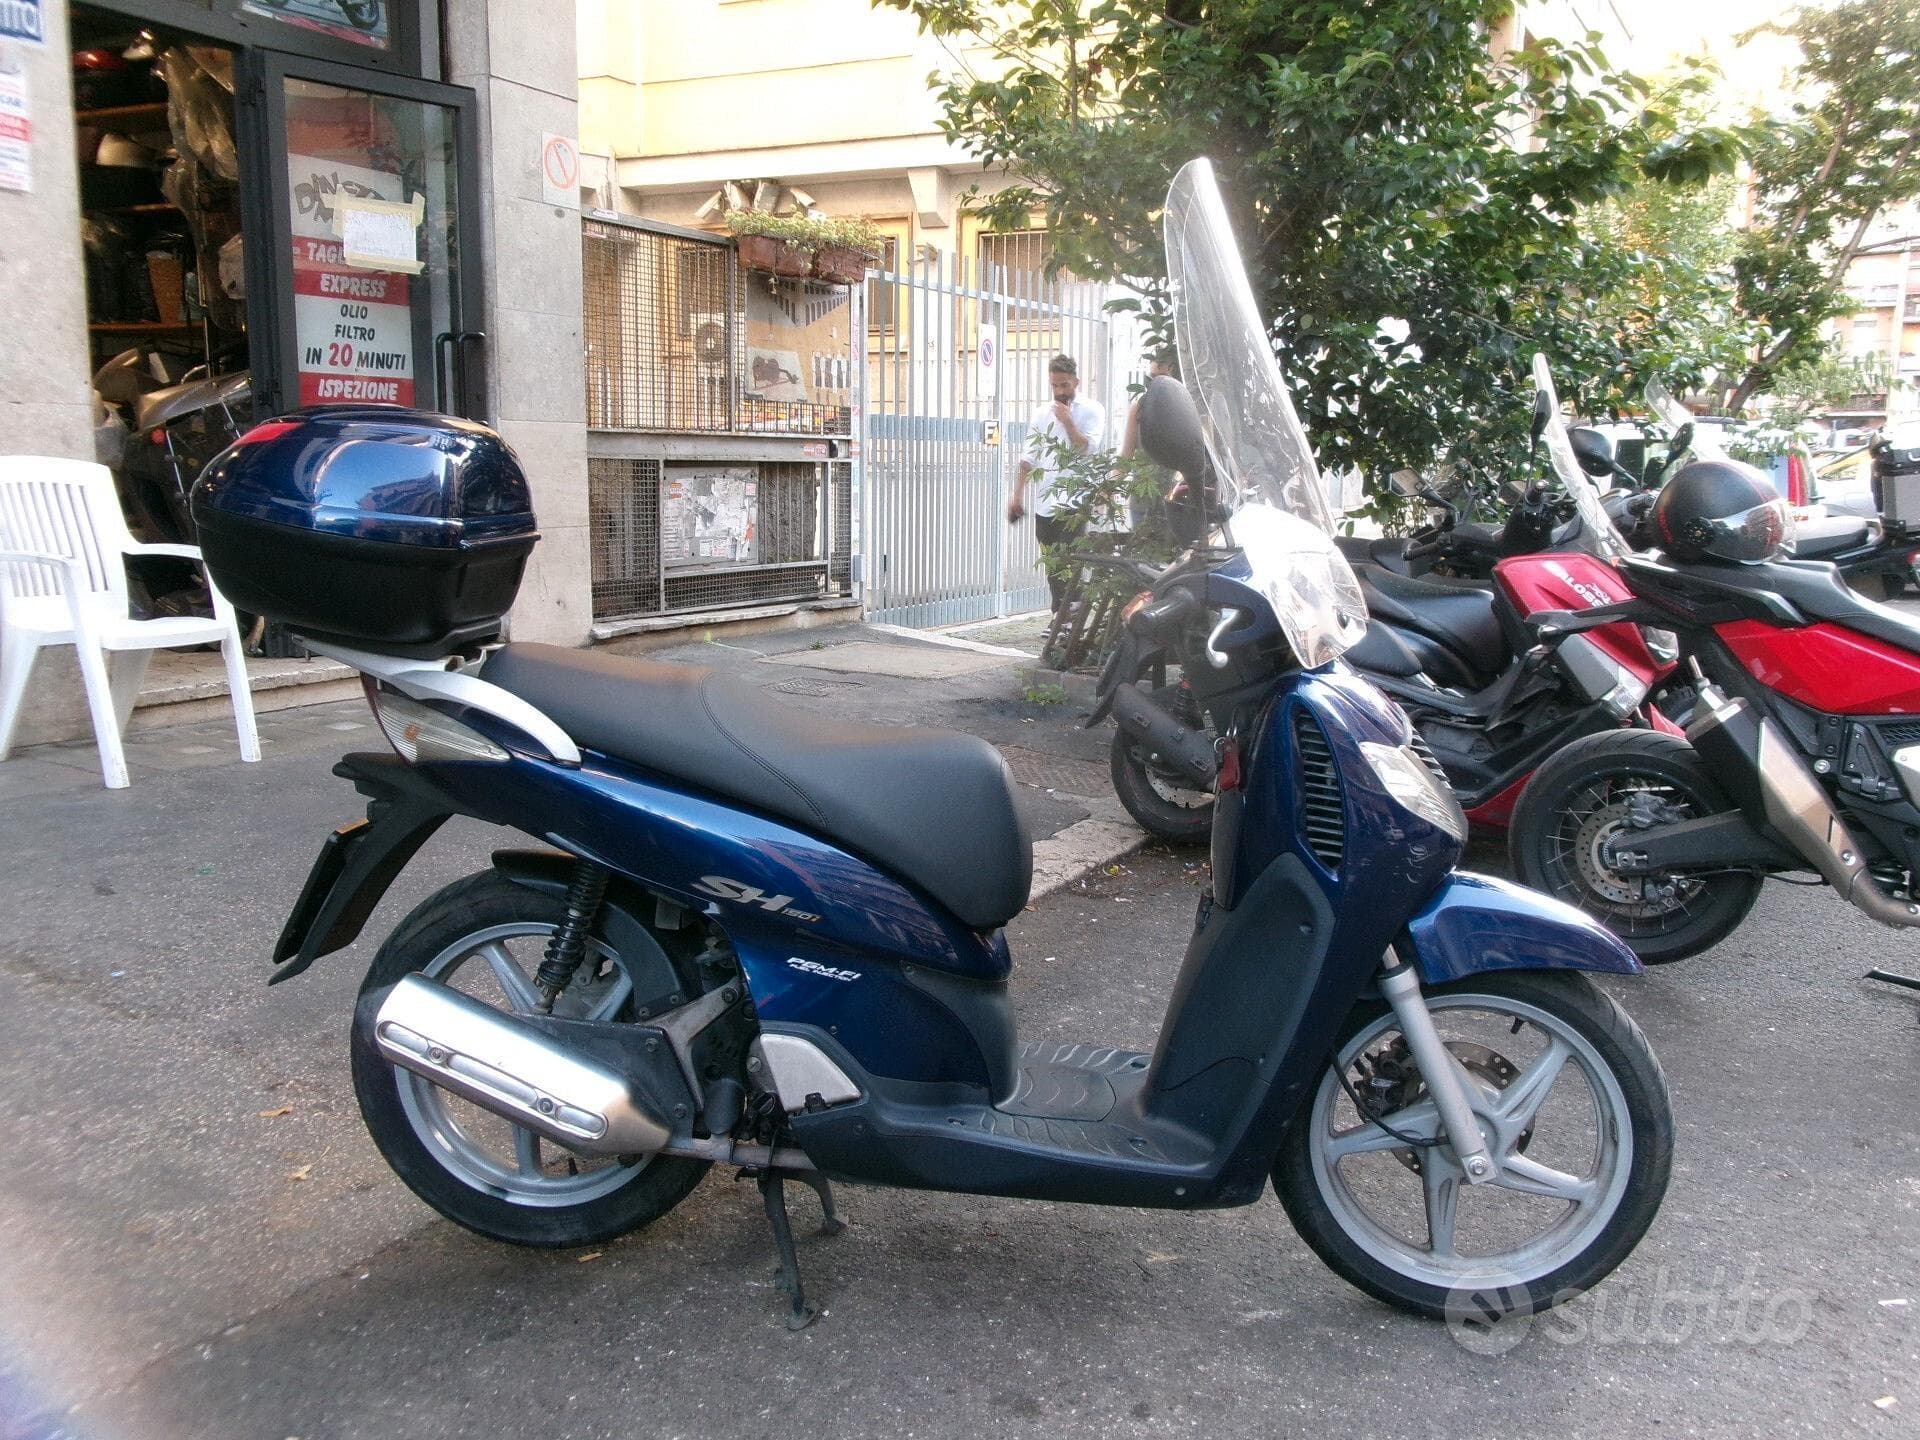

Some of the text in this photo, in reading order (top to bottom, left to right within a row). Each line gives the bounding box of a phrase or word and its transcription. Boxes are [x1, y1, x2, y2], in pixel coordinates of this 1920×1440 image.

[320, 273, 387, 298] EXPRESS
[340, 304, 368, 319] OLIO
[334, 324, 375, 341] FILTRO
[305, 342, 406, 370] IN 20 MINUTI
[318, 379, 398, 400] ISPEZIONE
